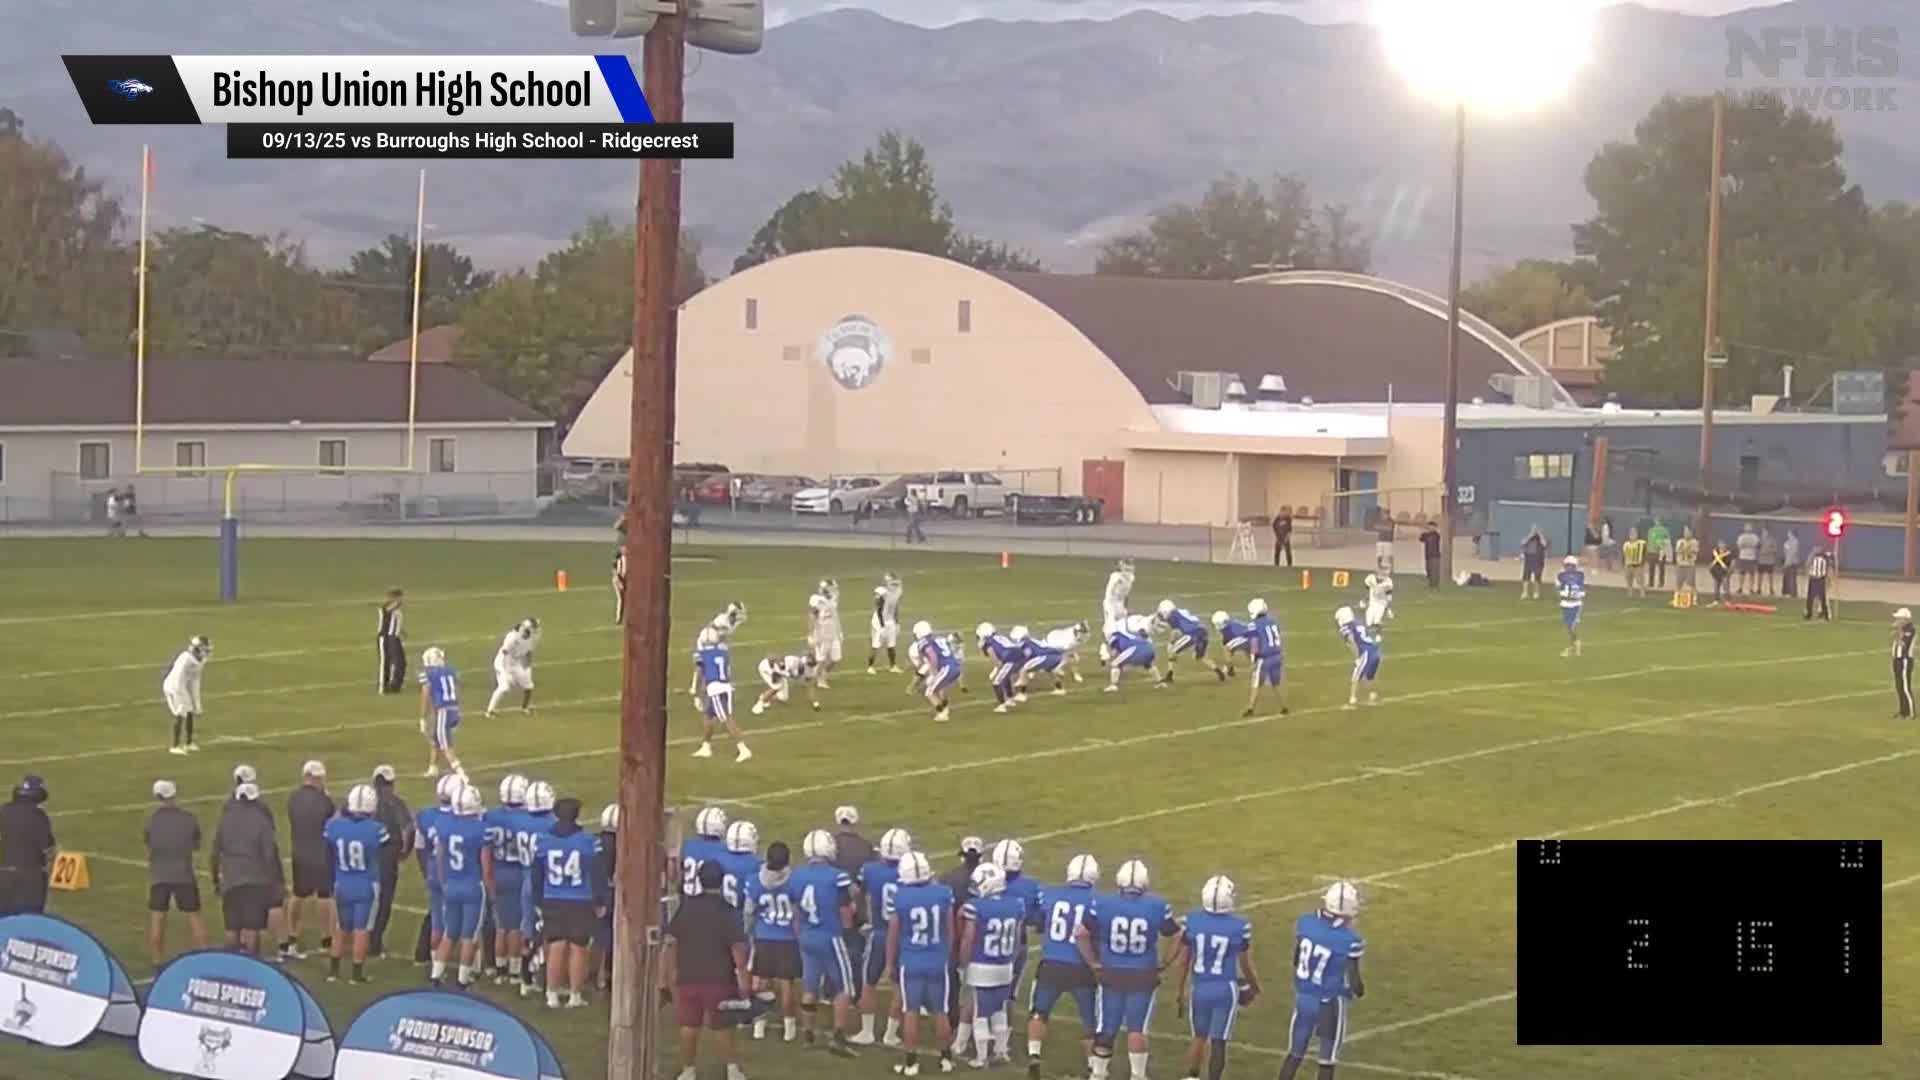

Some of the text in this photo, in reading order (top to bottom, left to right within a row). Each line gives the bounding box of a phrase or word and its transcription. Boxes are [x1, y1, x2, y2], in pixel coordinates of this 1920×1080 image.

[1828, 512, 1844, 535] 2
[714, 656, 726, 680] 1
[440, 675, 456, 701] 11
[55, 857, 77, 882] 20
[449, 834, 464, 871] 5
[547, 850, 583, 886] 54
[758, 894, 793, 926] 30
[801, 884, 819, 924] 4
[910, 904, 940, 947] 21
[984, 917, 1017, 957] 20
[1050, 901, 1085, 944] 61
[1110, 916, 1148, 954] 66
[7, 938, 78, 971] PROUD SPONSOR
[1193, 933, 1229, 975] 17
[1296, 938, 1331, 985] 87
[188, 978, 266, 1008] PROUD SPONSOR
[397, 1017, 494, 1051] PROUD SPONSOR
